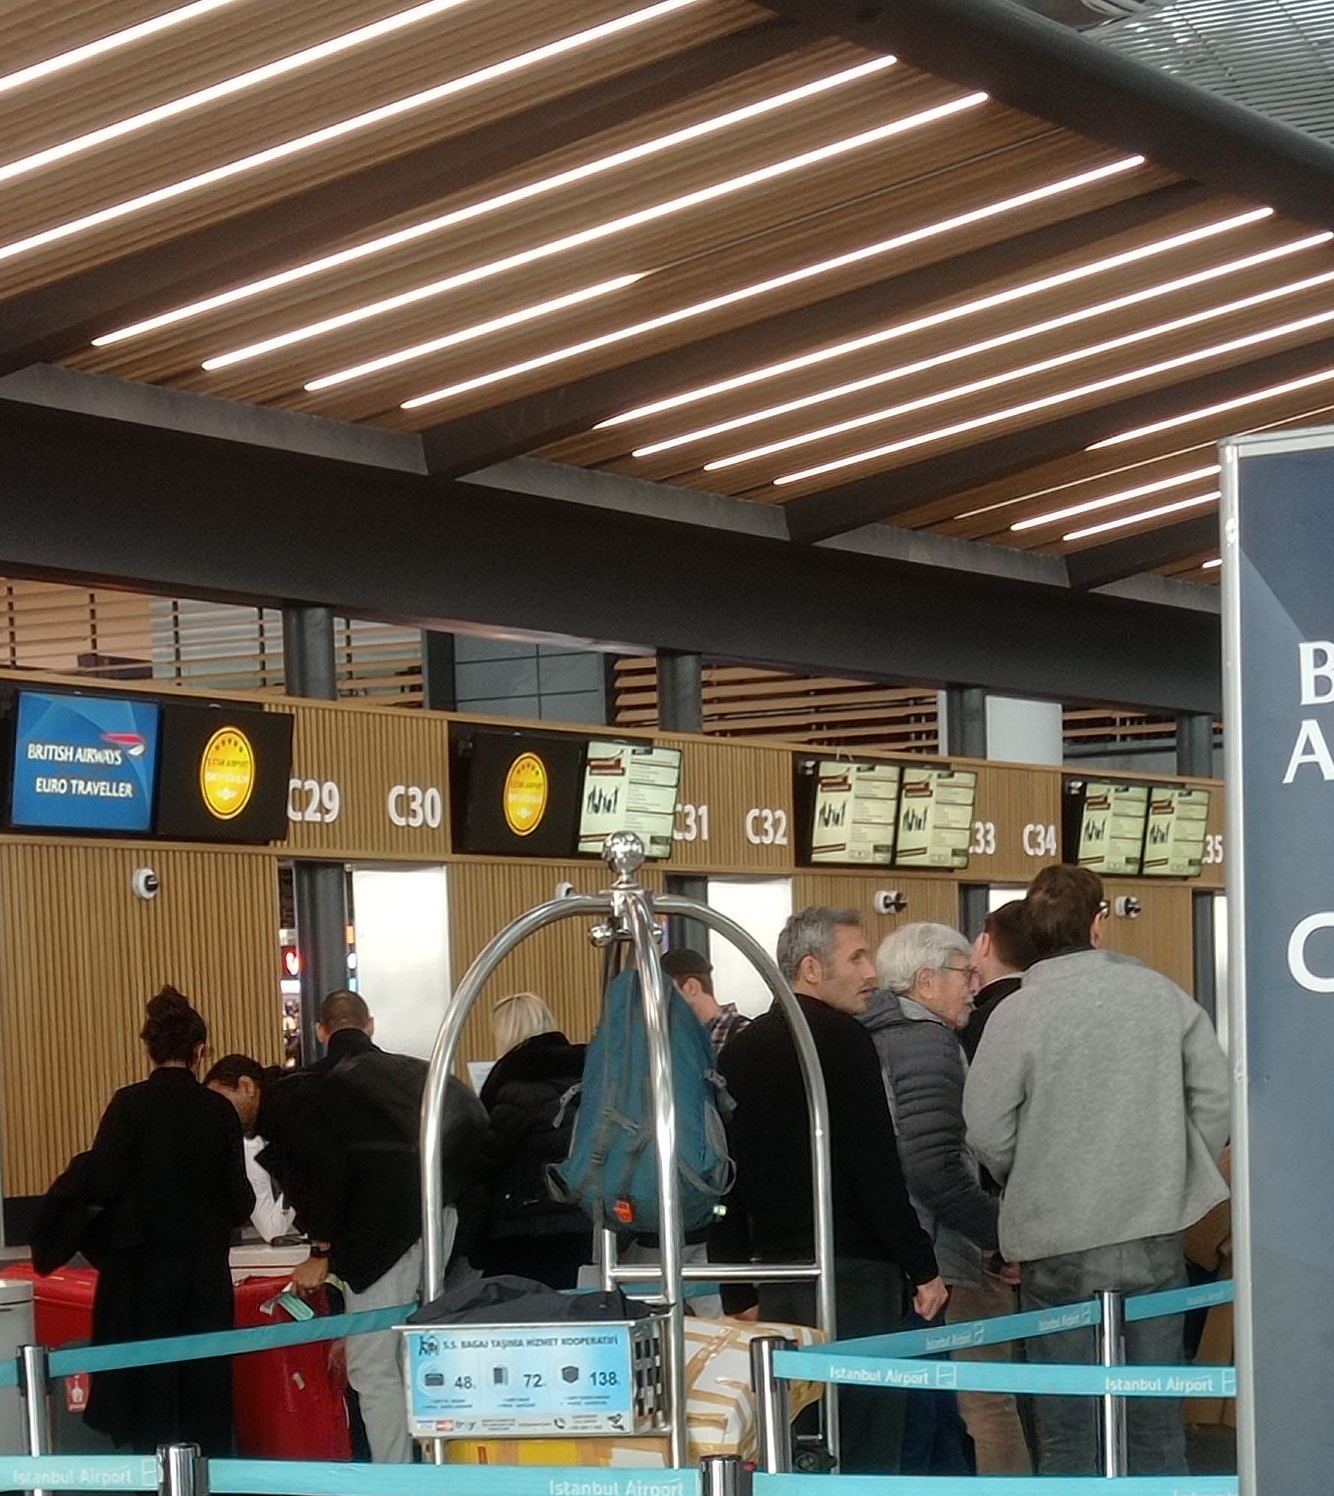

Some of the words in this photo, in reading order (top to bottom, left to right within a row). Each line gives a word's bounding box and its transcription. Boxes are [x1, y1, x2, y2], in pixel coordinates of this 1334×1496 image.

[28, 743, 74, 762] BRITISH
[75, 747, 122, 765] AIRWAYS
[36, 777, 67, 793] EURO
[71, 779, 133, 798] TRAVELLER
[287, 779, 339, 823] C29
[388, 785, 442, 828] C30
[746, 808, 787, 845] C32
[969, 821, 995, 854] 33
[1023, 824, 1056, 856] C34
[1201, 834, 1223, 863] 35
[523, 1374, 543, 1387] 72
[589, 1372, 617, 1386] 138
[830, 1366, 881, 1382] Istanbul
[884, 1369, 931, 1385] Airport
[1105, 1376, 1162, 1391] Istanbul
[1165, 1376, 1213, 1393] Airport
[13, 1469, 75, 1484] Istanbul
[79, 1469, 132, 1487] Airport
[550, 1480, 619, 1496] Istanbul
